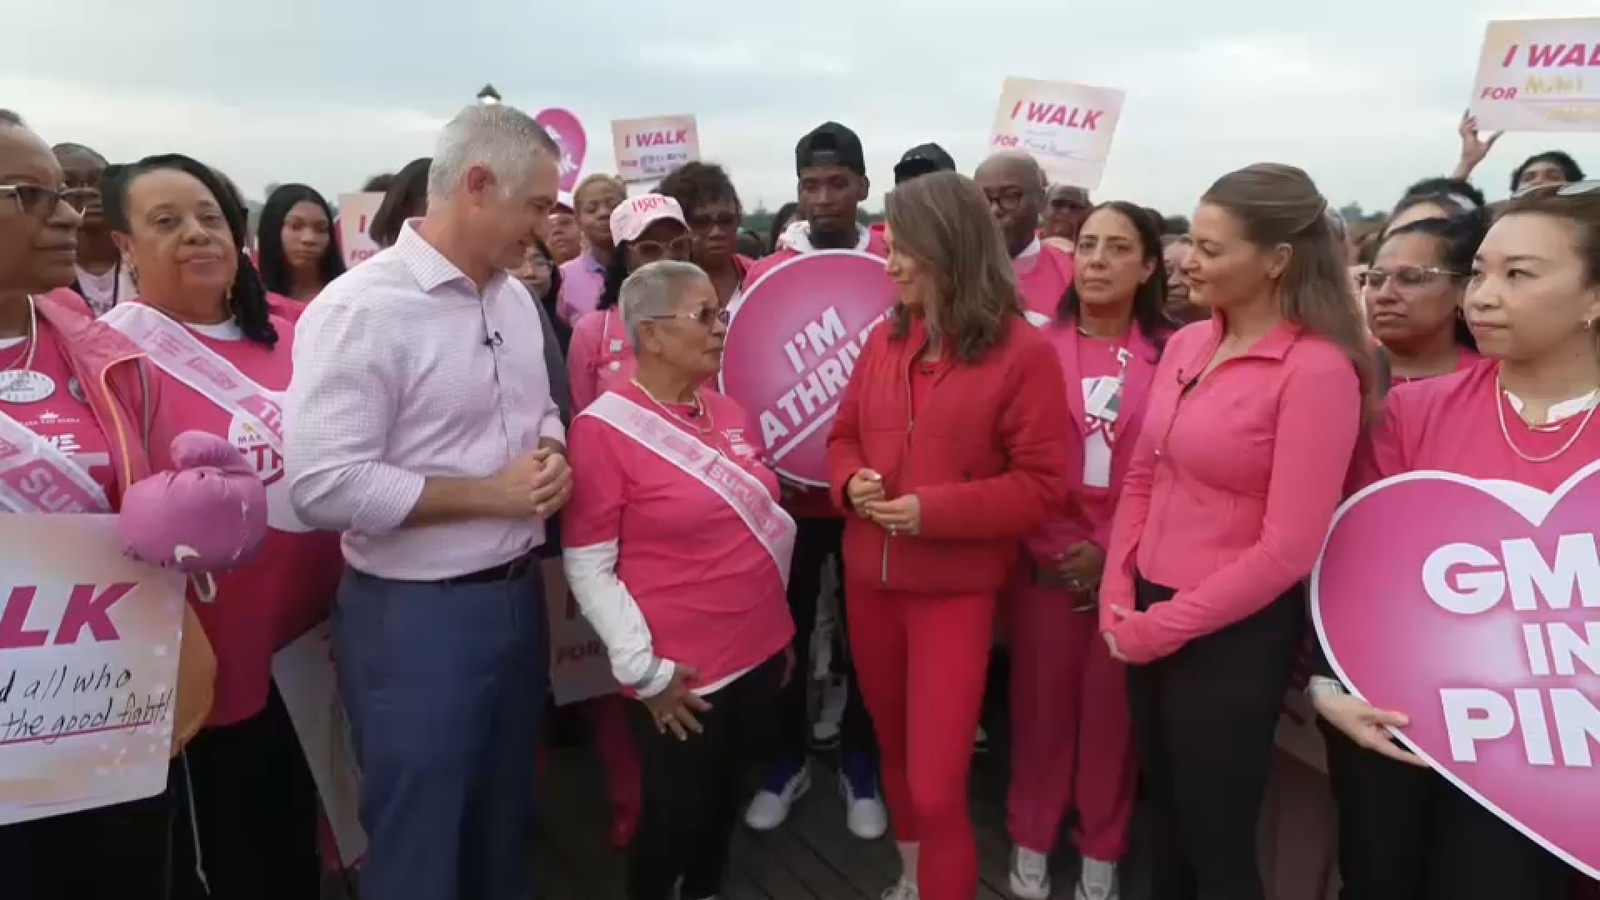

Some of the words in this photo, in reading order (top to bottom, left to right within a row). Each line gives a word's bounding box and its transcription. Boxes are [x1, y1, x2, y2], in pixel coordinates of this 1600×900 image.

[1501, 43, 1518, 68] I
[1480, 86, 1518, 100] FOR
[1011, 99, 1022, 120] I
[1026, 102, 1103, 131] WALK
[624, 133, 631, 150] I
[635, 129, 687, 148] WALK
[994, 134, 1019, 147] FOR
[359, 214, 367, 234] I
[784, 305, 847, 374] I'M
[759, 409, 789, 450] A
[0, 581, 139, 650] LK
[23, 663, 68, 701] all
[73, 662, 133, 694] who
[0, 707, 45, 742] the
[43, 696, 114, 745] good
